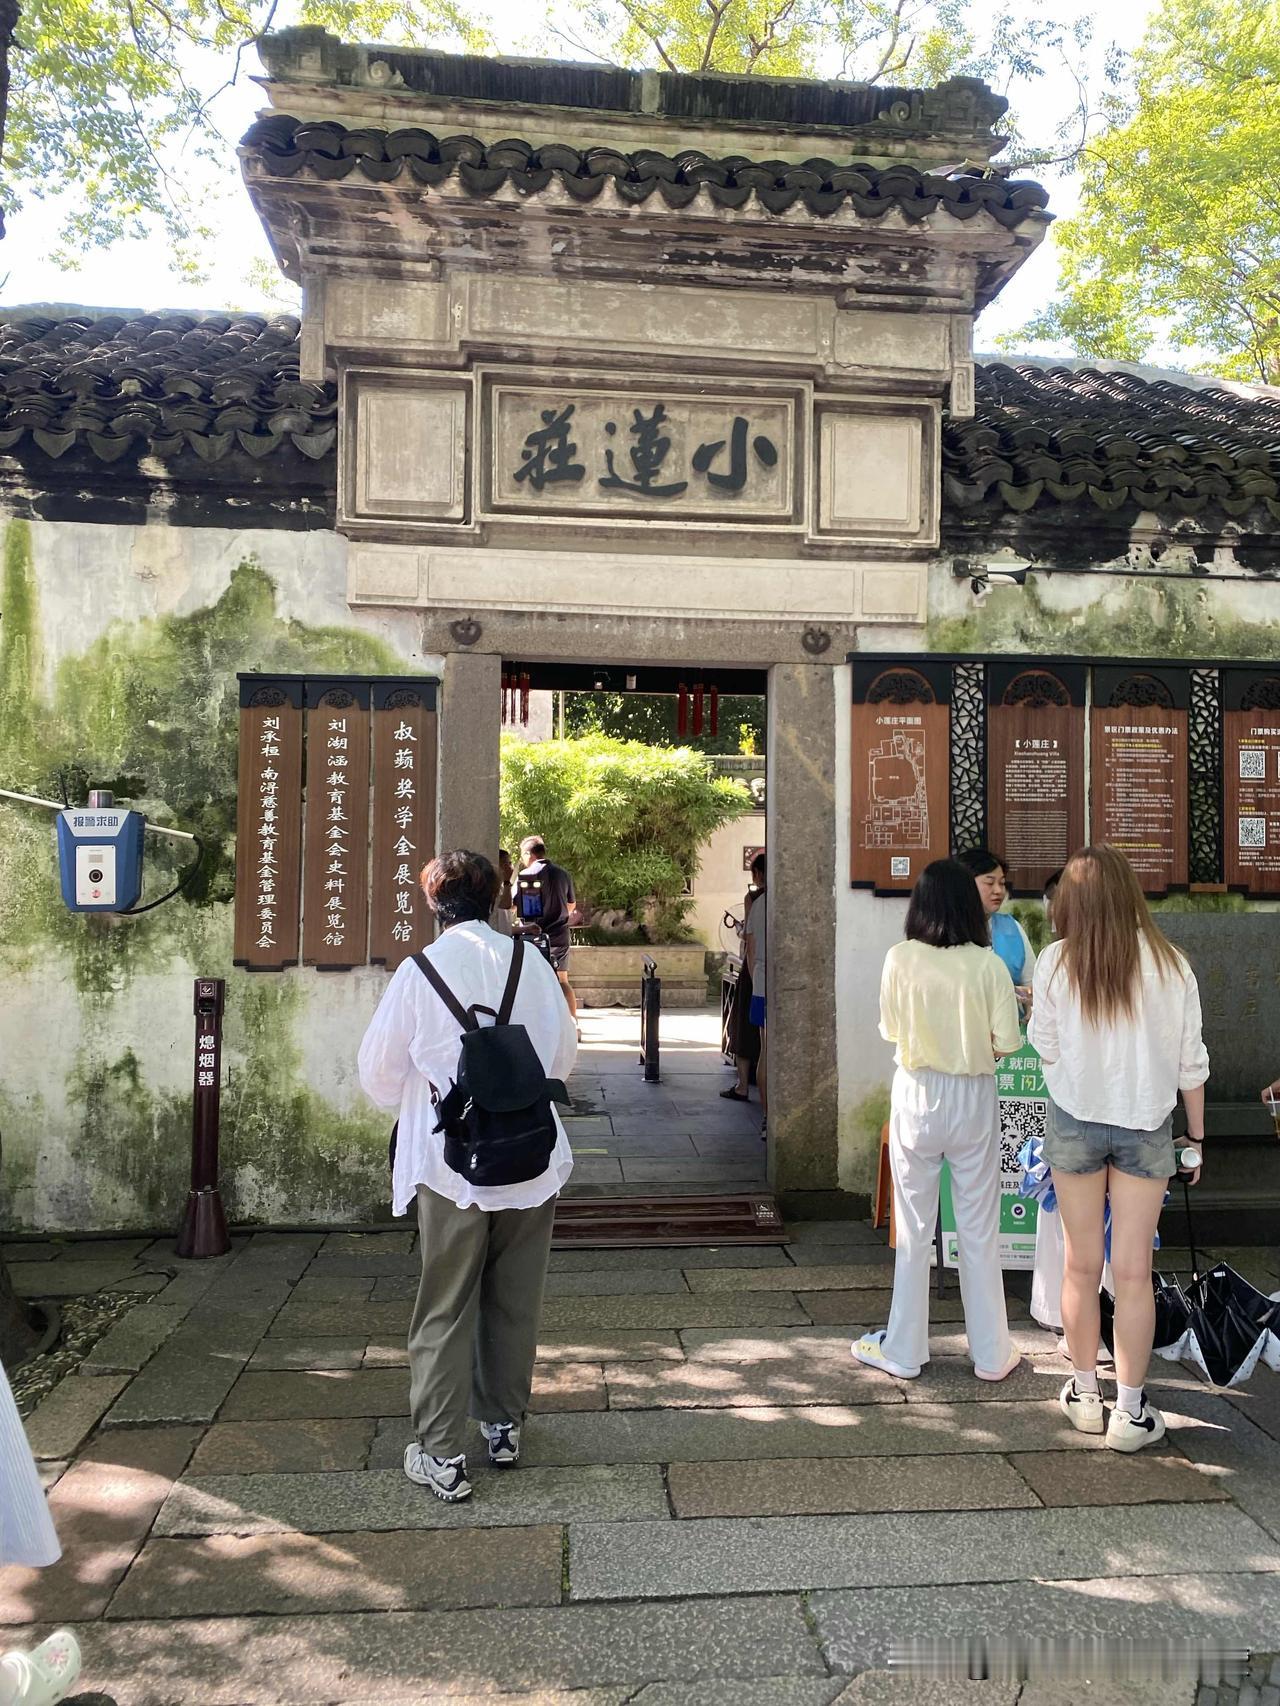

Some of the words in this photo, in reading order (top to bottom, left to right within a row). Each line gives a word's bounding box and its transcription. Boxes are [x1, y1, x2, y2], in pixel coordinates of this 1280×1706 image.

[73, 815, 119, 828] 报警求助
[198, 1034, 216, 1087] 熄烟器
